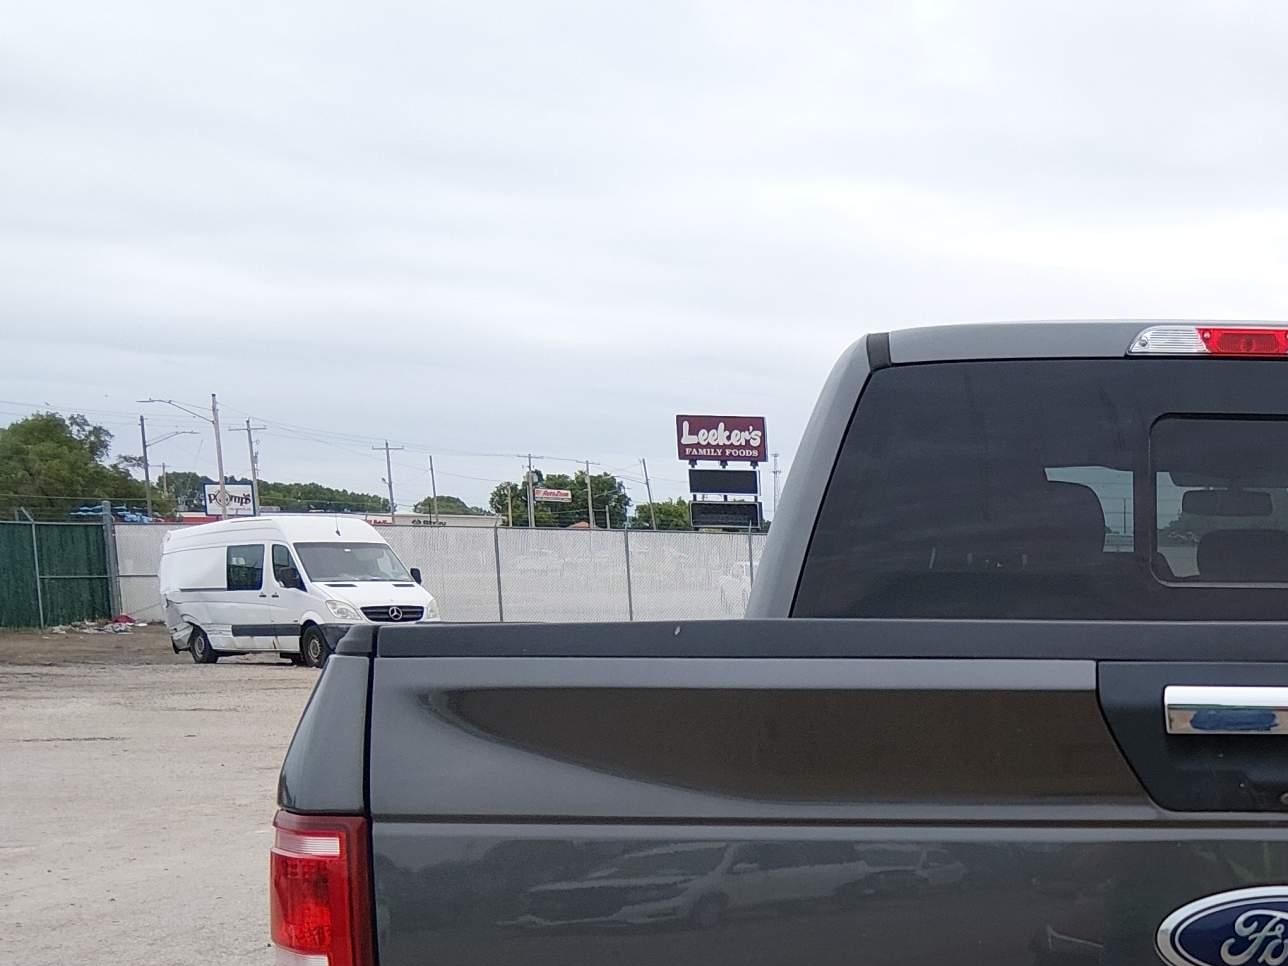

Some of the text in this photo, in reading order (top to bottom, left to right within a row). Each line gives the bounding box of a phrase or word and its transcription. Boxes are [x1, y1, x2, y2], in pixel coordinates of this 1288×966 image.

[681, 420, 761, 447] Leeker's
[685, 447, 759, 457] FAMILY FOODS
[542, 490, 569, 498] AutoZ
